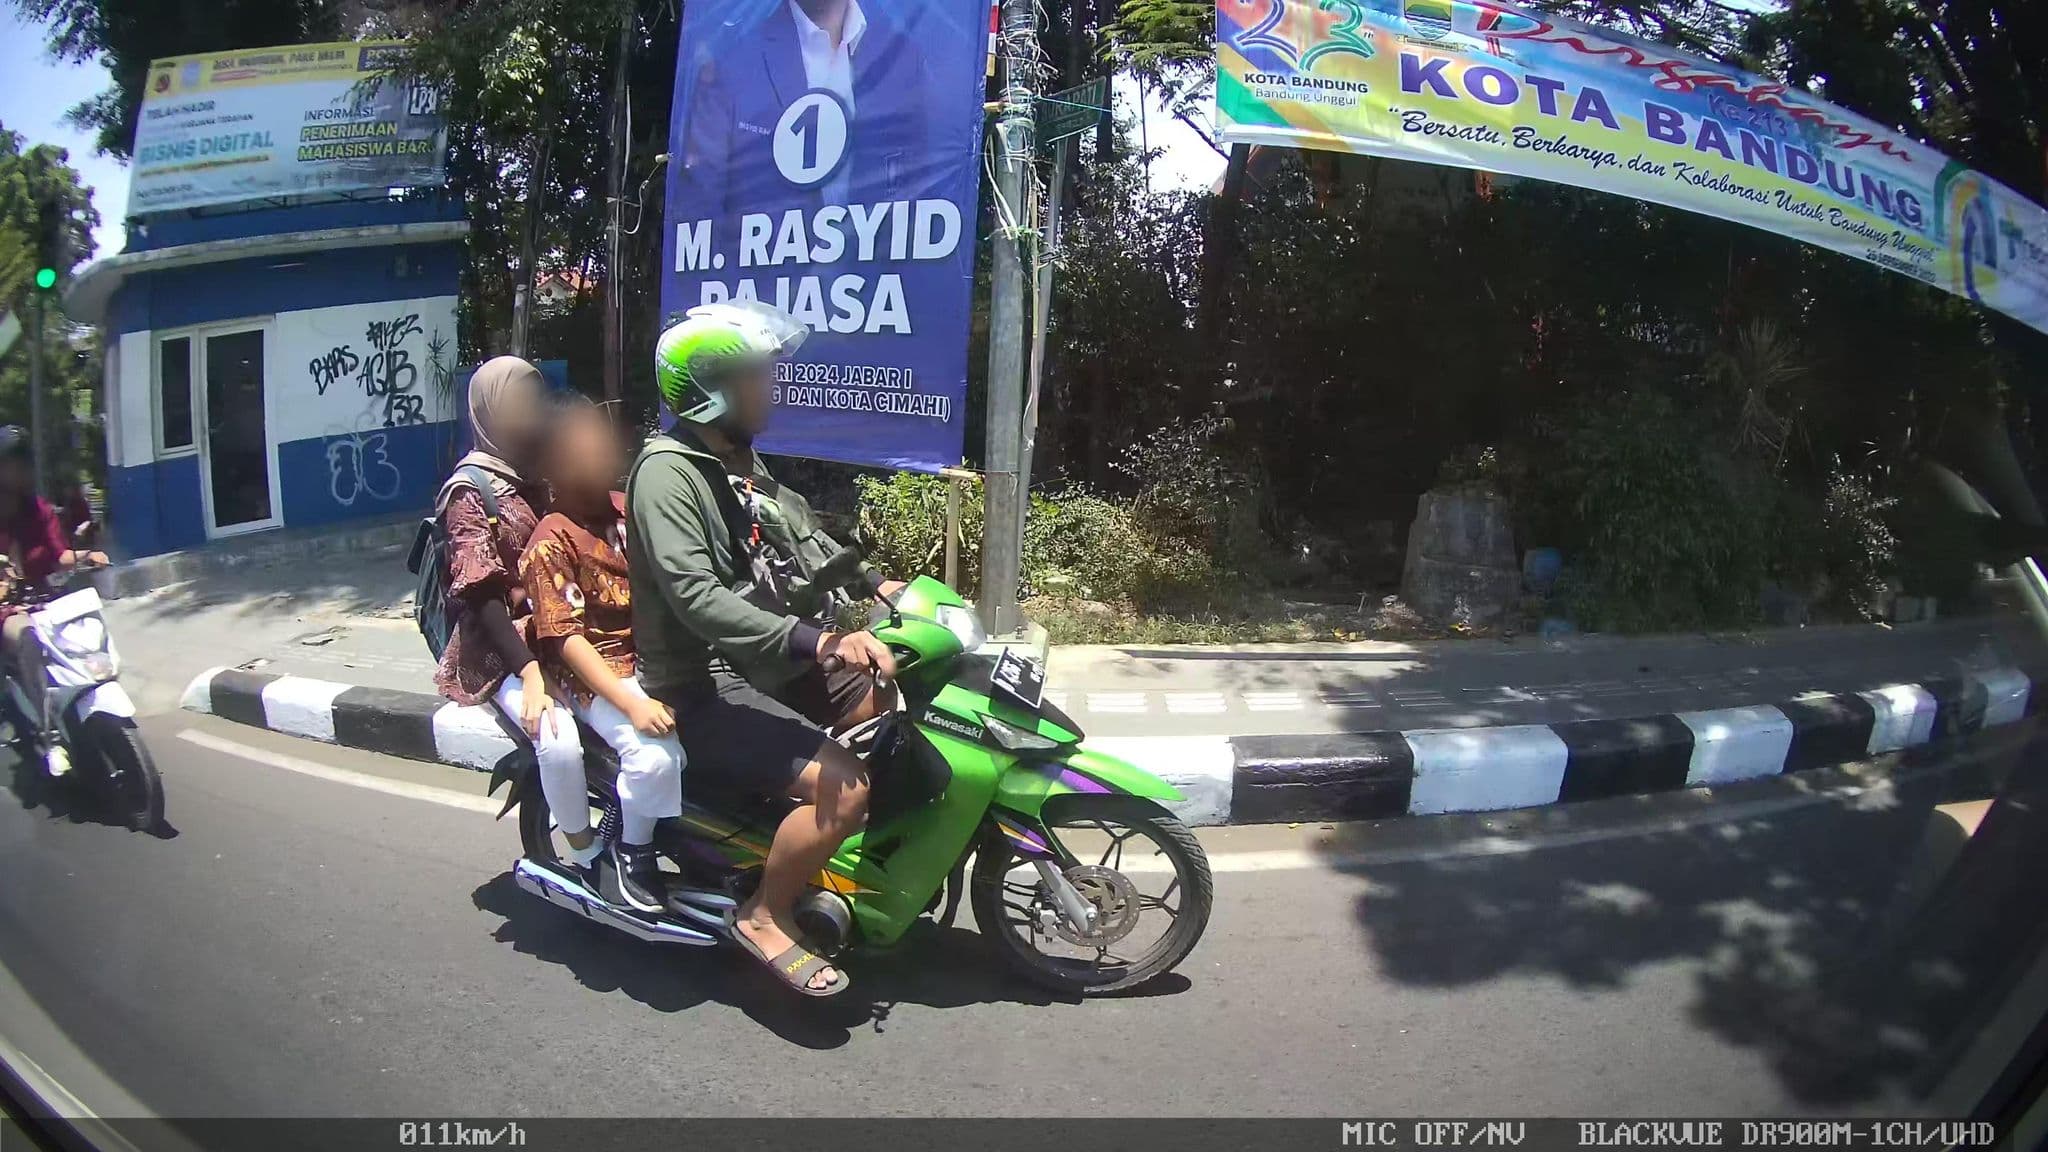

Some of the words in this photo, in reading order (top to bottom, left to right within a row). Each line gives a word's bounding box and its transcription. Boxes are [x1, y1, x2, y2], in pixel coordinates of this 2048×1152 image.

[1244, 73, 1287, 86] KOTA
[1292, 76, 1368, 94] BANDUNG
[1255, 88, 1310, 104] Bandung
[304, 106, 374, 121] INFORMASI
[302, 122, 398, 140] PENERIMAAN
[790, 104, 821, 169] 1
[1400, 53, 1621, 131] KOTA
[1643, 101, 1923, 230] BANDUNG
[140, 138, 197, 164] BISNIS
[199, 130, 275, 155] DIGITAL
[299, 145, 394, 160] MAHASISWA
[396, 141, 432, 154] BAR
[1627, 154, 1666, 177] dan
[1673, 162, 1770, 205] Kolaborasi
[1774, 190, 1824, 222] Untuk
[674, 219, 725, 272] M.
[738, 199, 962, 267] RASYID
[795, 363, 840, 385] 2024
[841, 365, 901, 389] JABAR
[903, 368, 913, 390] I
[786, 386, 823, 406] DAN
[825, 388, 873, 411] KOTA
[873, 391, 951, 423] CIMAHI)
[923, 709, 984, 740] Kawasaki
